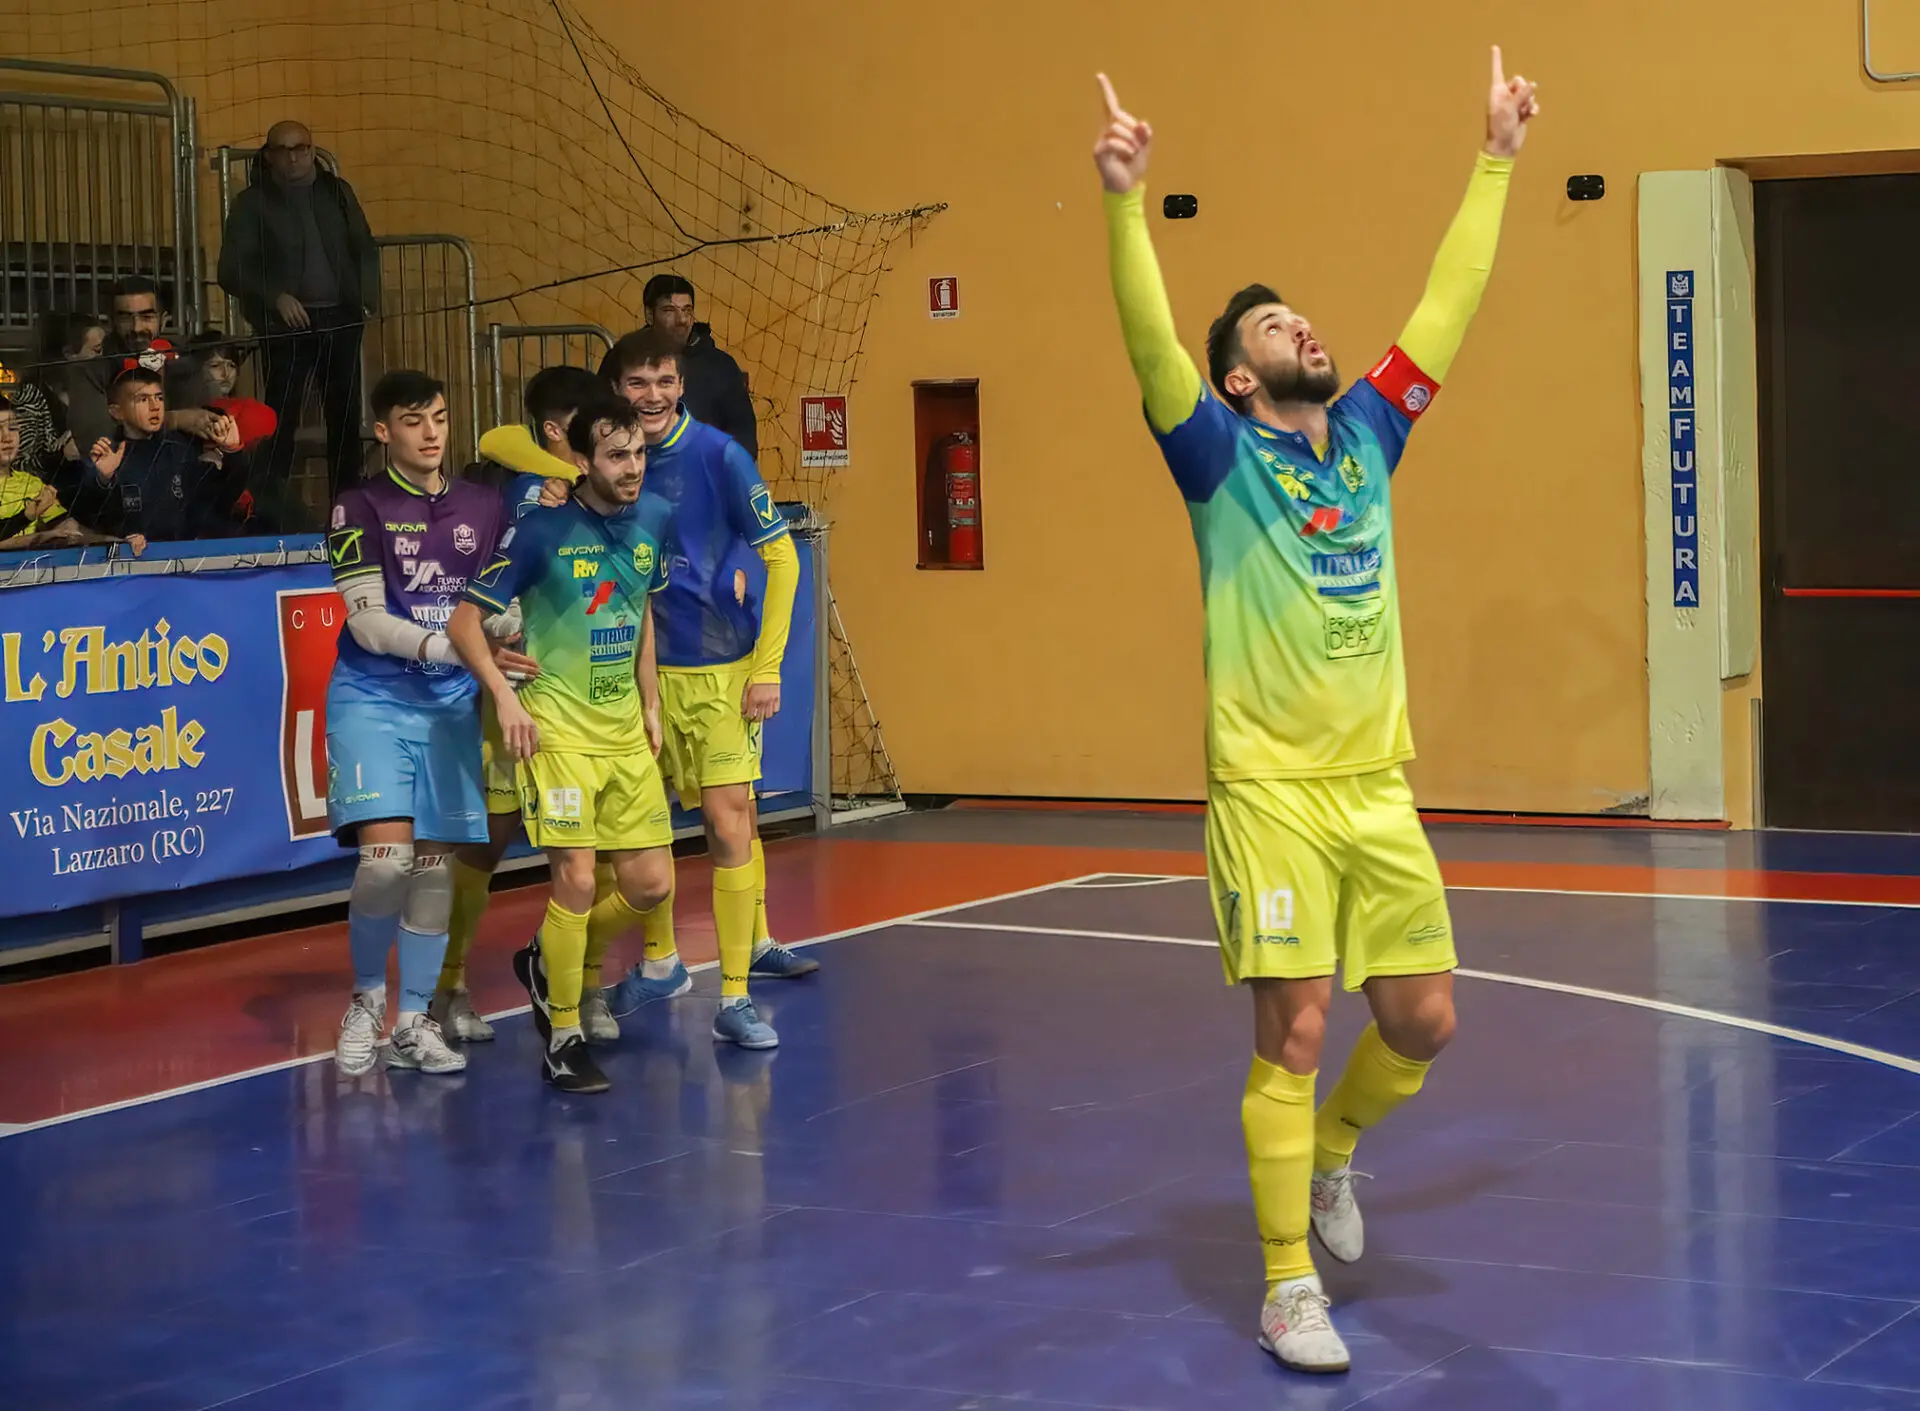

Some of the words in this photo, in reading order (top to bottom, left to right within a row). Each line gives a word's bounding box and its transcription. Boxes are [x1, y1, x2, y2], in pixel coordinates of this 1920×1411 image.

[2, 617, 229, 702] L'Antico
[30, 705, 205, 787] Casale
[10, 807, 56, 840] Via
[61, 788, 189, 834] Nazionale,
[195, 787, 234, 816] 227
[52, 840, 144, 876] Lazzaro
[152, 824, 206, 864] (RC)
[1259, 889, 1293, 930] 10
